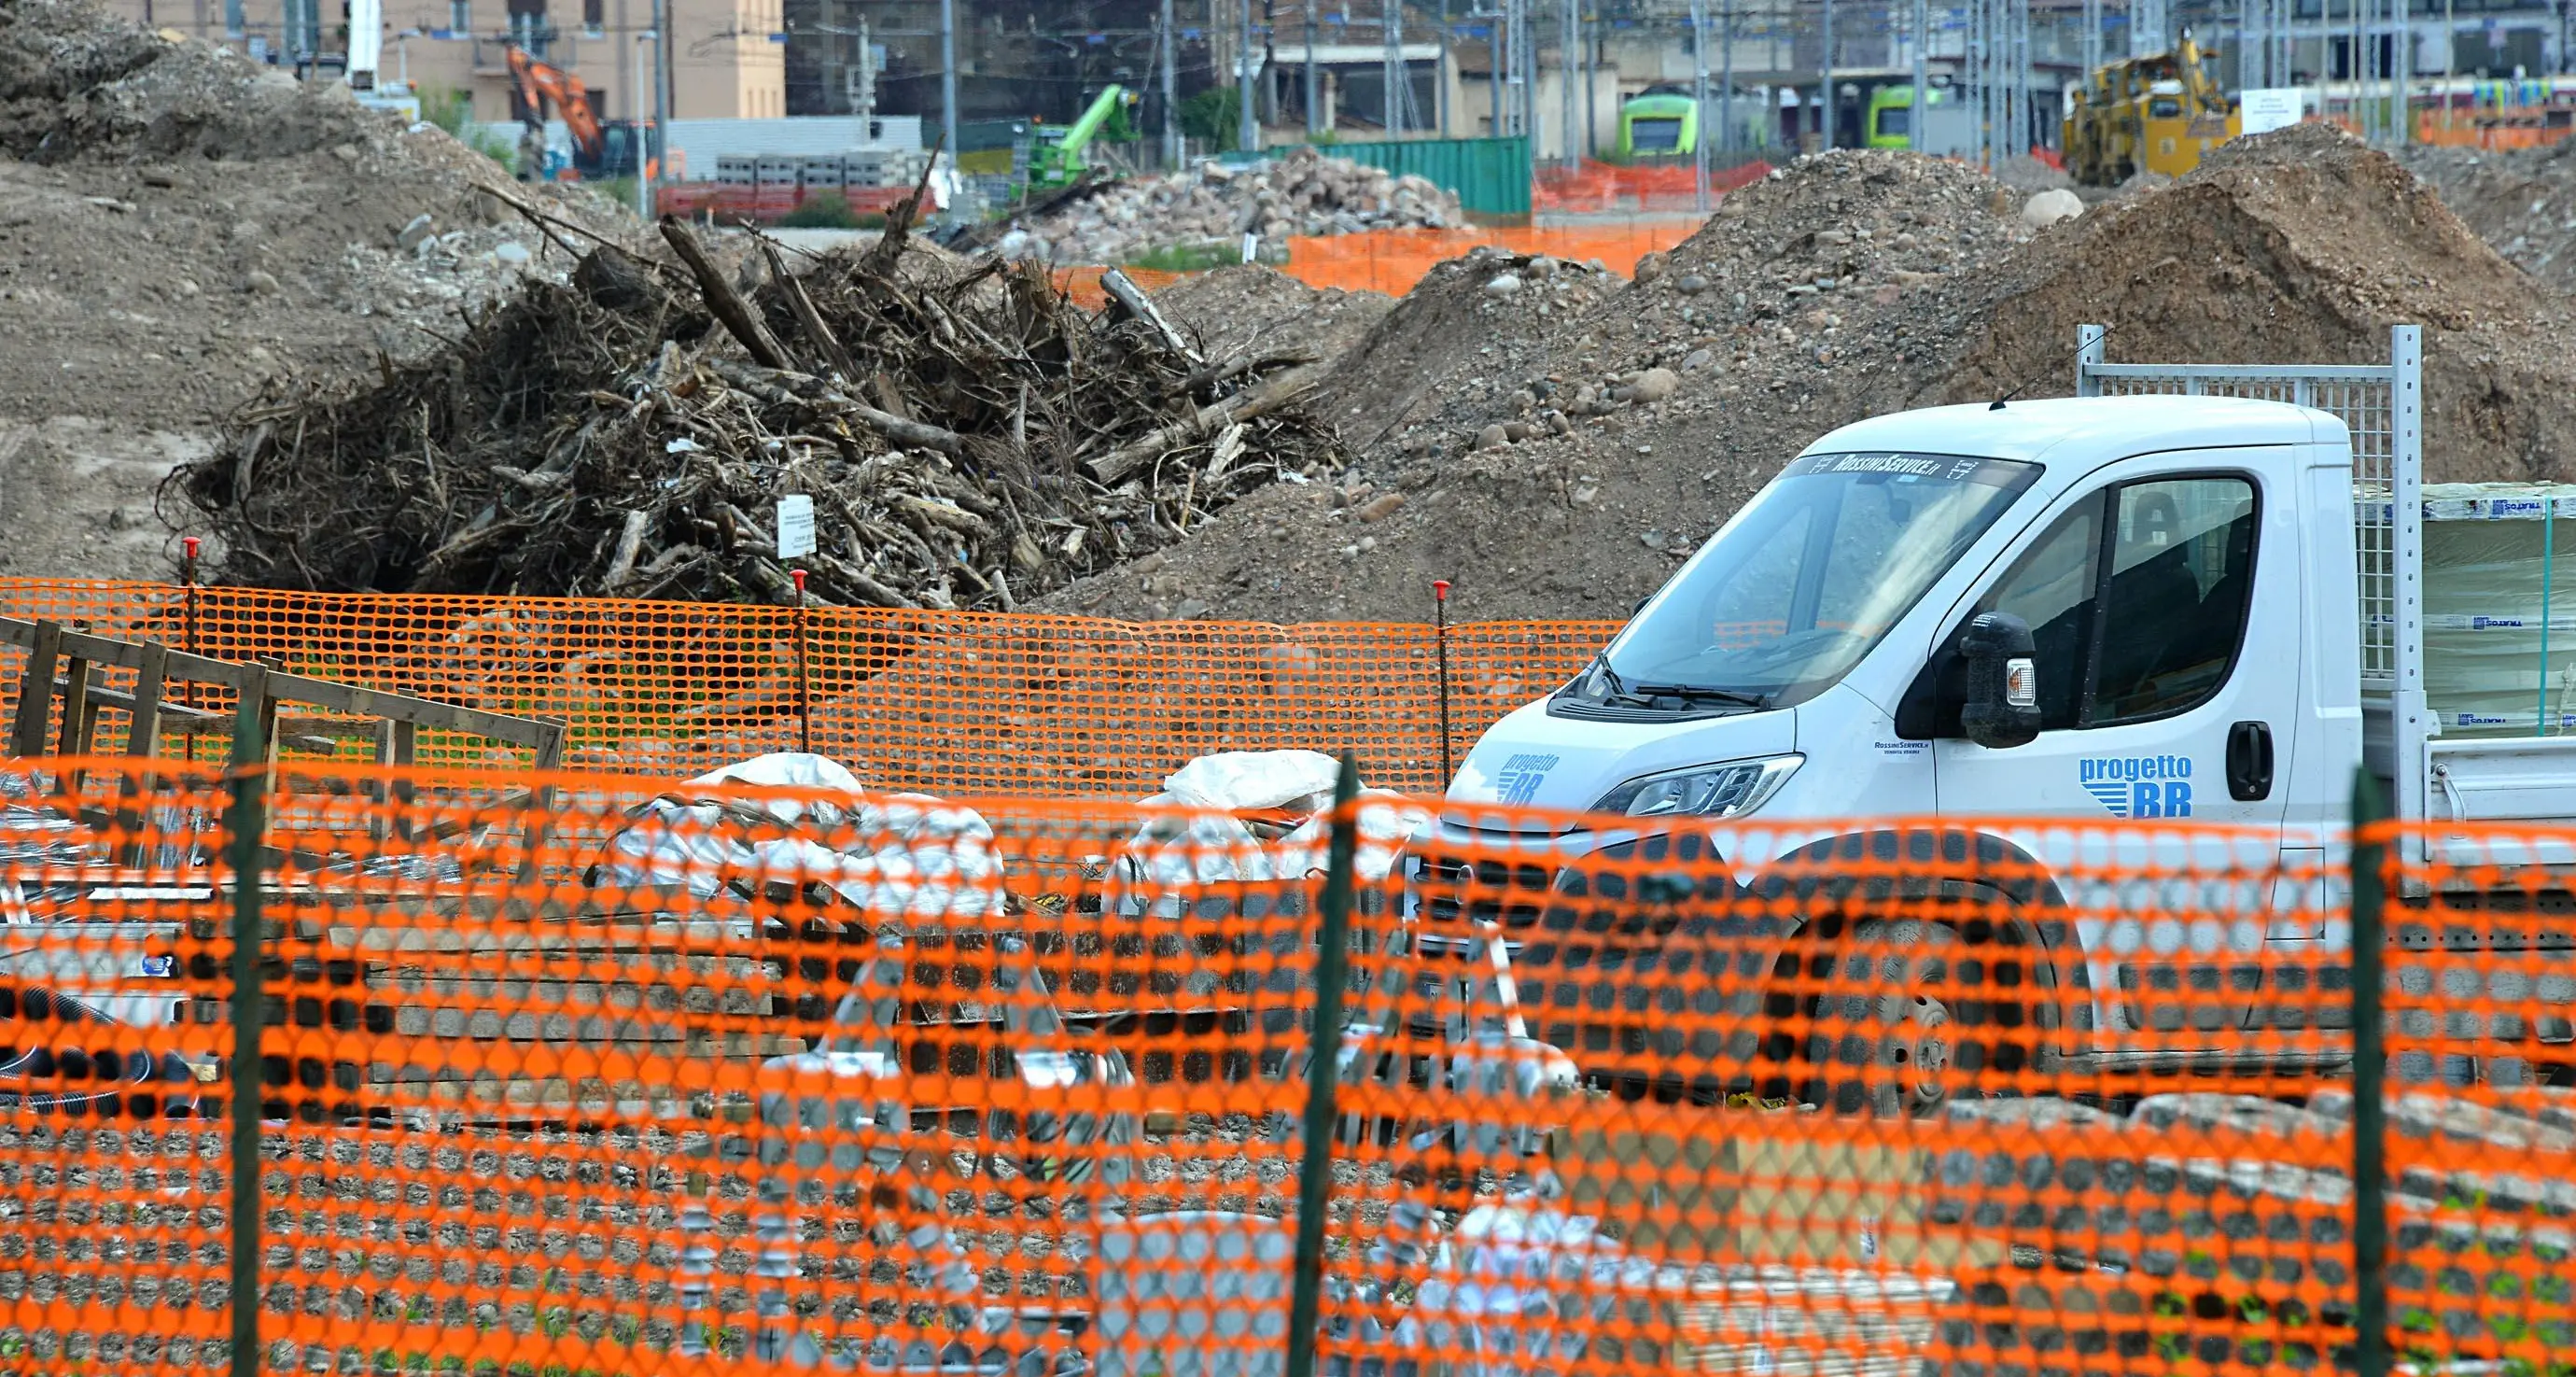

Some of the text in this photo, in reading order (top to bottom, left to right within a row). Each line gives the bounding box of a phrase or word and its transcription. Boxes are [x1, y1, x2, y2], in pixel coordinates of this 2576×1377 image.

[2504, 502, 2541, 511] TRATOS
[1501, 753, 1561, 772] progetto
[2079, 754, 2192, 782] progetto
[2133, 781, 2192, 820] BR
